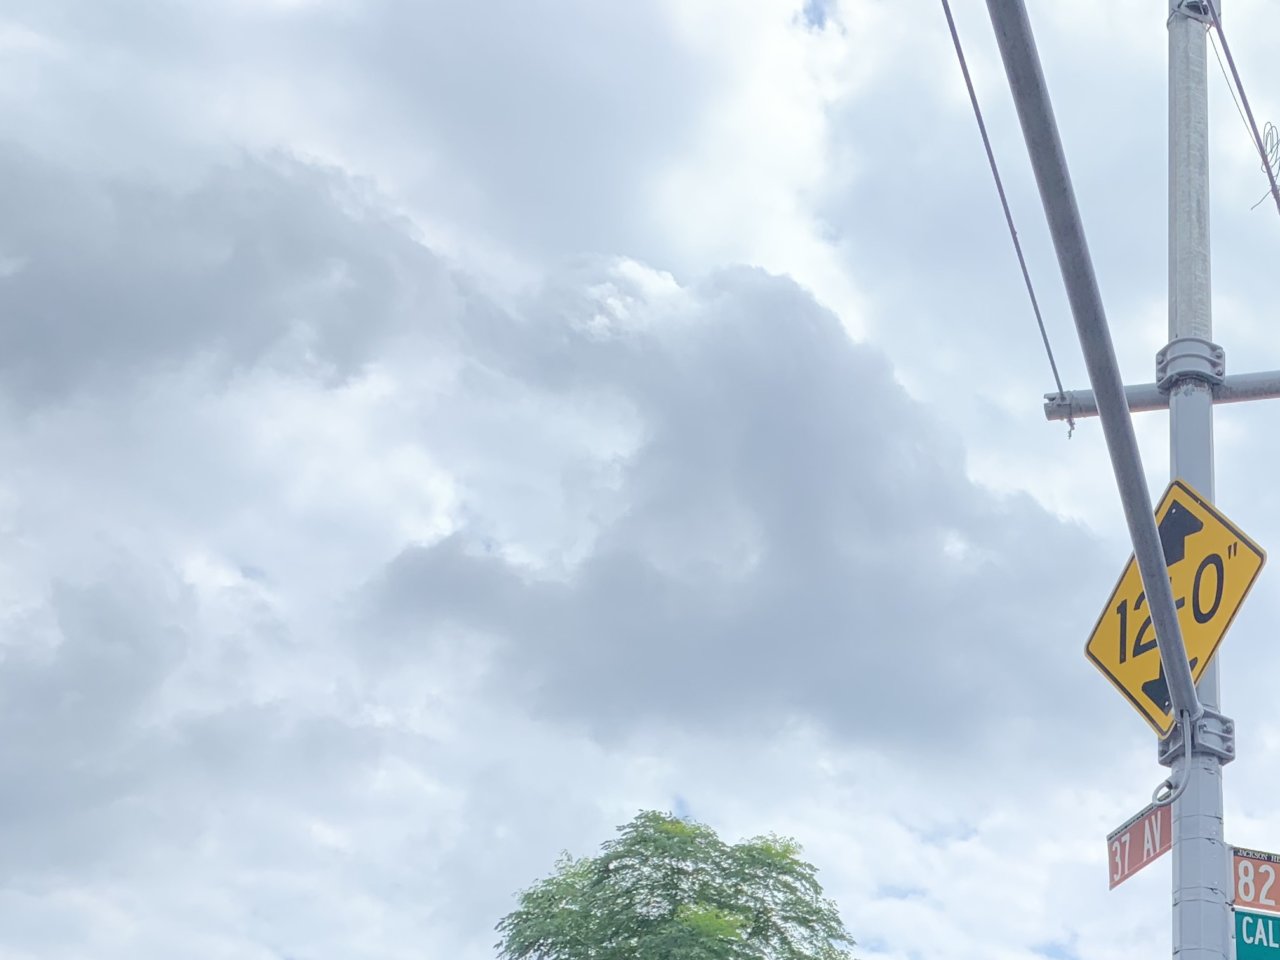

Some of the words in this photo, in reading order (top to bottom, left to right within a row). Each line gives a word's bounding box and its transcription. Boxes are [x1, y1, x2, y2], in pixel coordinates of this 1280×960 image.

[1111, 832, 1130, 881] 37
[1142, 810, 1161, 863] AV
[1237, 849, 1268, 860] JACKSON
[1237, 859, 1276, 906] 82
